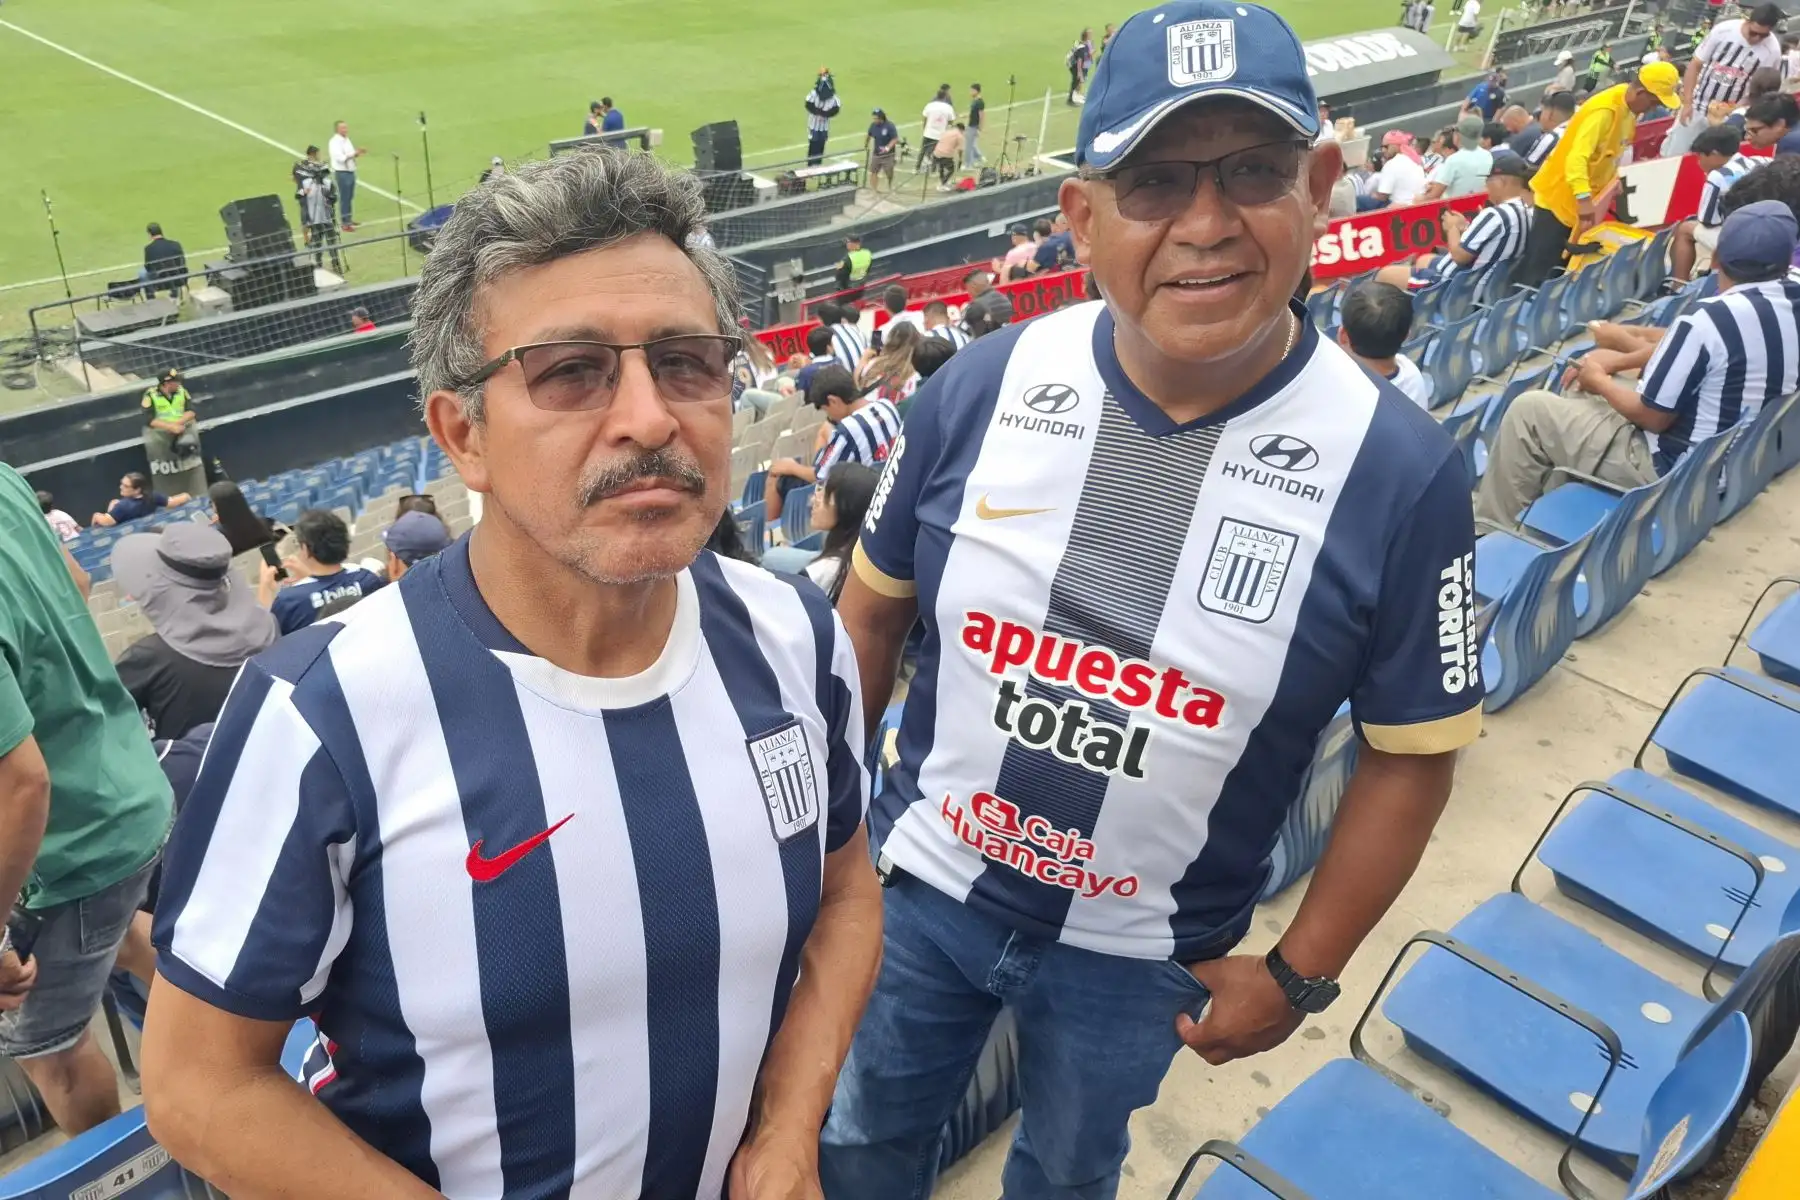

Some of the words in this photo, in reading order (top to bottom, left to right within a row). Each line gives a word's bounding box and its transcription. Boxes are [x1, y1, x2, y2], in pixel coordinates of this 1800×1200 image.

[1180, 23, 1222, 33] ALIANZA
[1172, 45, 1181, 65] CLUB
[1222, 39, 1232, 59] LIMA
[1192, 71, 1214, 80] 1901
[999, 411, 1085, 440] HYUNDAI
[1222, 461, 1325, 503] HYUNDAI
[1230, 526, 1285, 547] ALIANZA
[1209, 546, 1228, 580] CLUB
[1265, 560, 1285, 593] LIMA
[1223, 602, 1244, 615] 1901
[1438, 557, 1466, 694] TORITO
[961, 610, 1226, 730] apuesta
[758, 729, 798, 754] ALIANZA
[993, 679, 1151, 779] total
[800, 752, 813, 790] LIMA
[761, 769, 779, 809] CLUB
[941, 793, 1138, 898] Huancayo
[1025, 816, 1095, 861] Caja
[113, 1167, 135, 1187] 41
